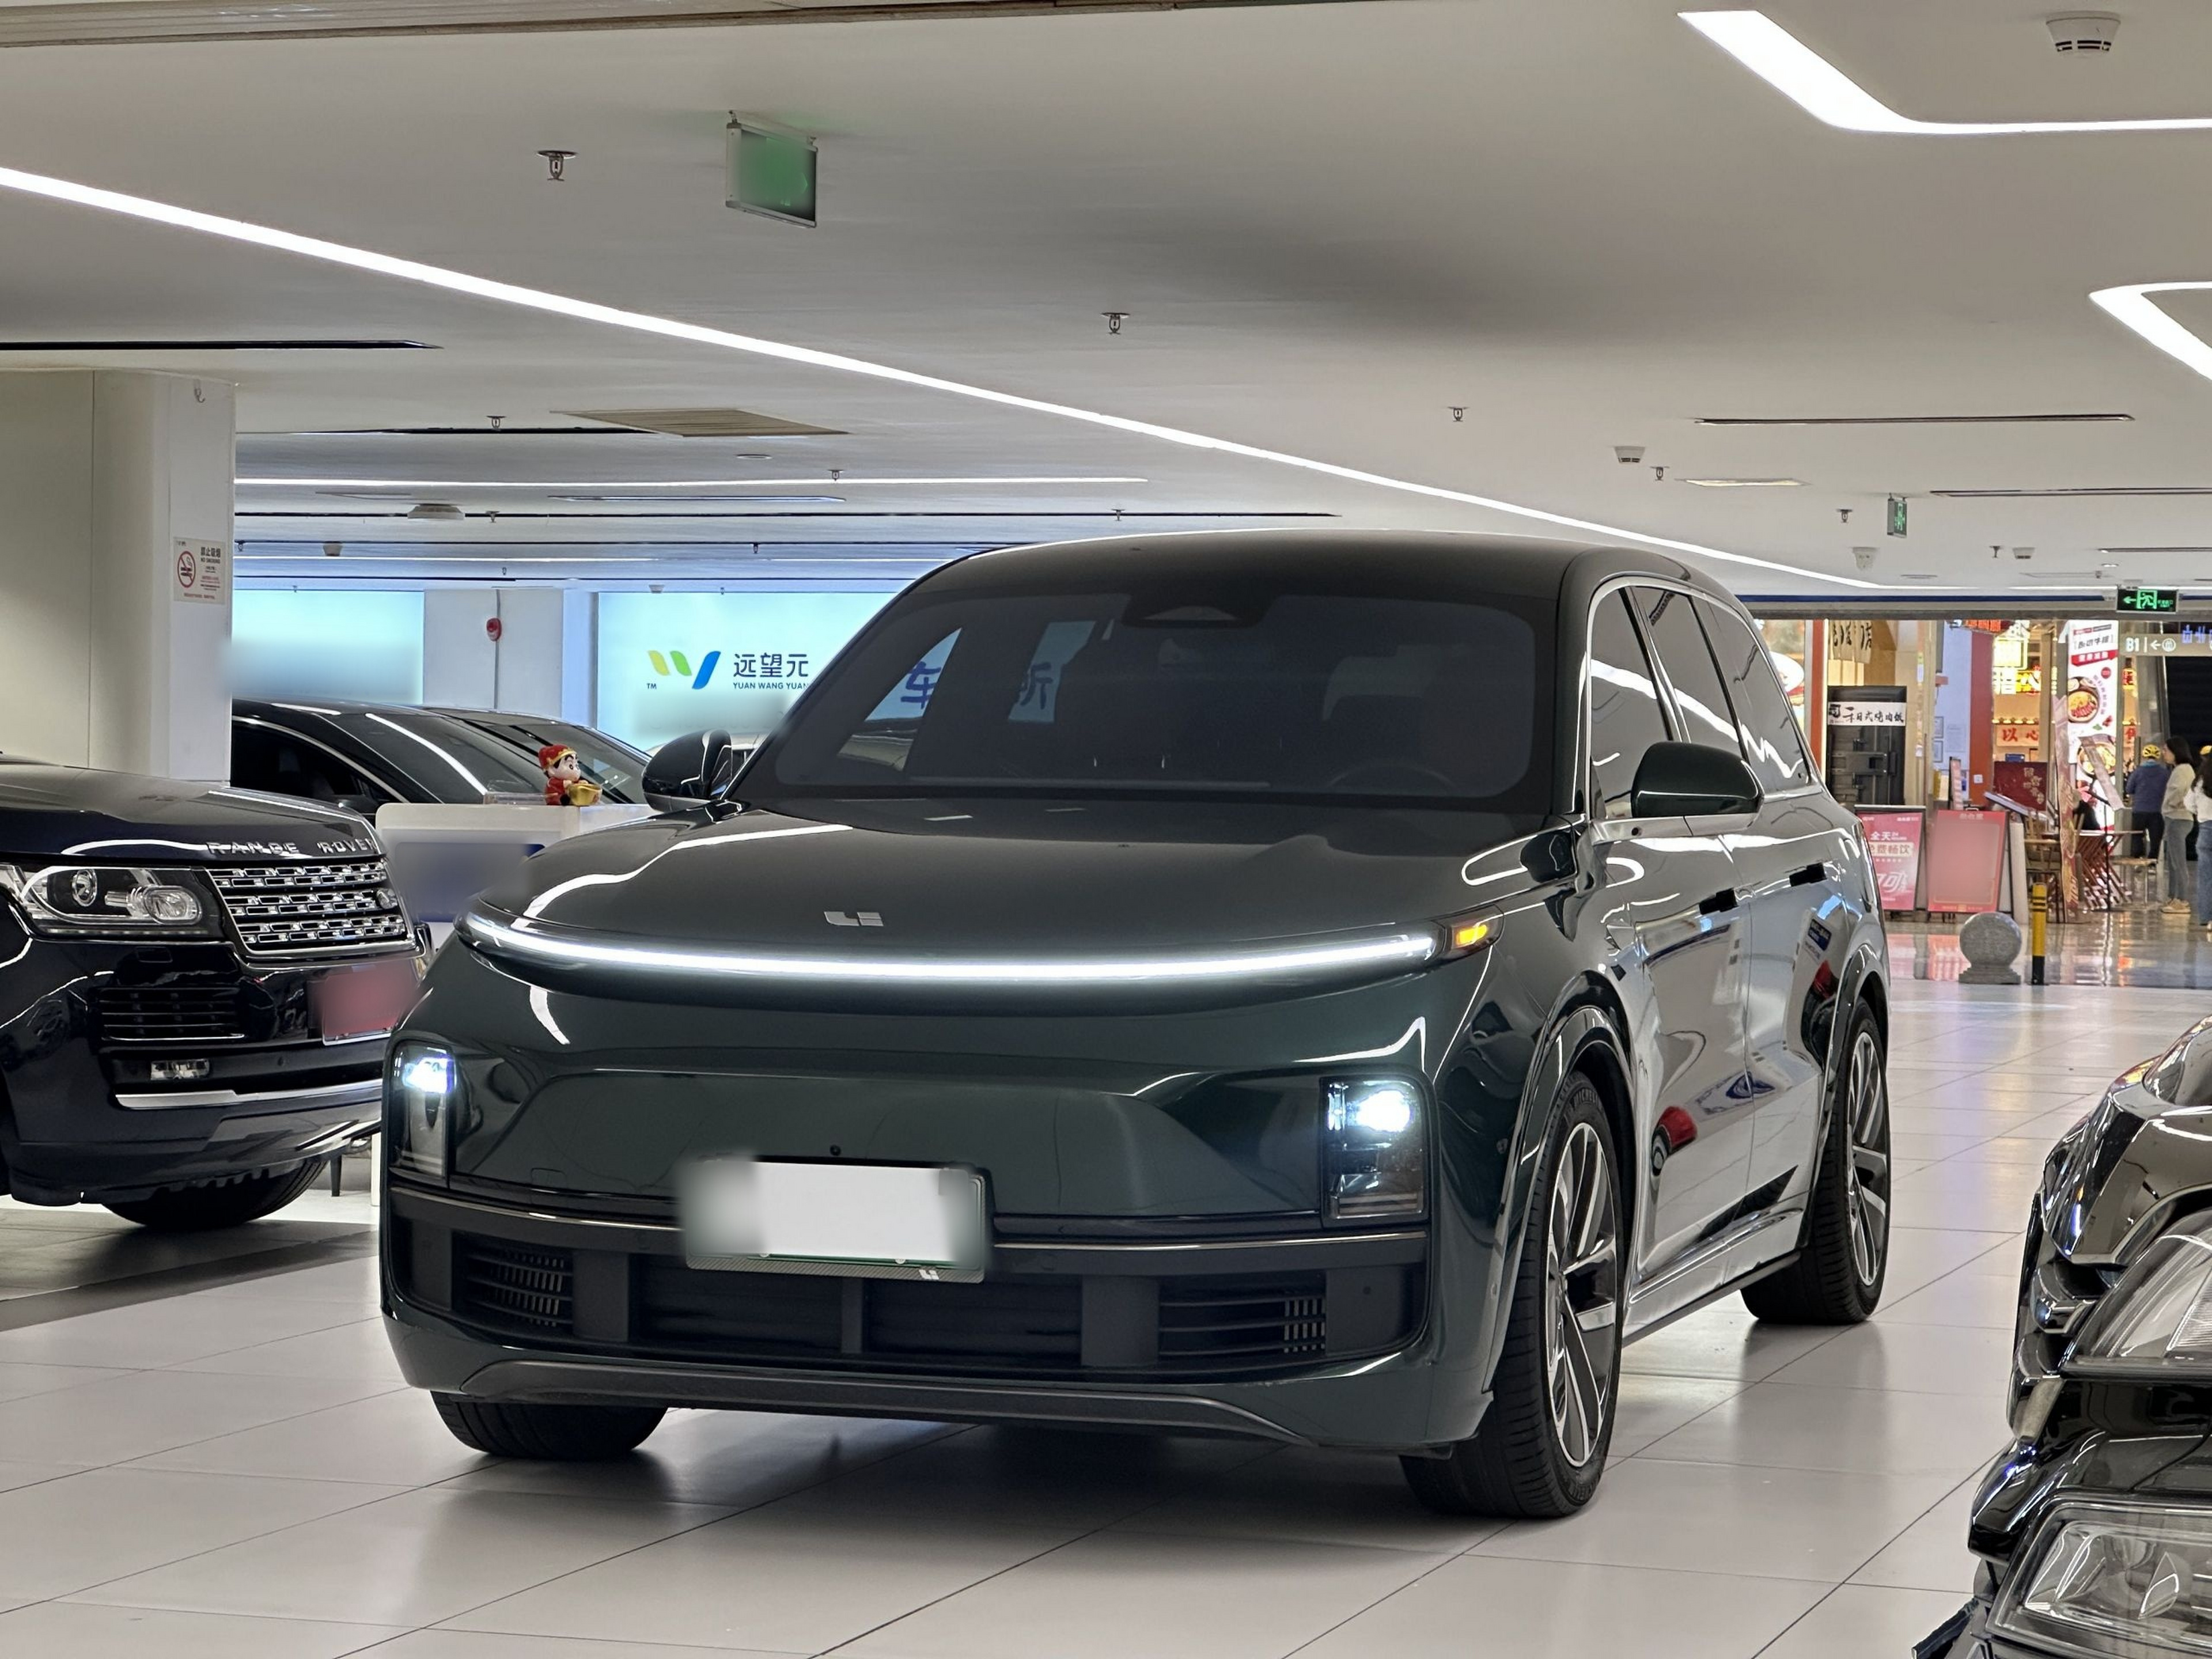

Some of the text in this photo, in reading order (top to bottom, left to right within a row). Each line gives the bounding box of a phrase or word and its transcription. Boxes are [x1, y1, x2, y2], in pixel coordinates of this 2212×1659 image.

[2126, 637, 2139, 652] B1
[733, 652, 809, 677] 远望元
[1870, 831, 1891, 841] 全天
[206, 840, 300, 855] RANGE
